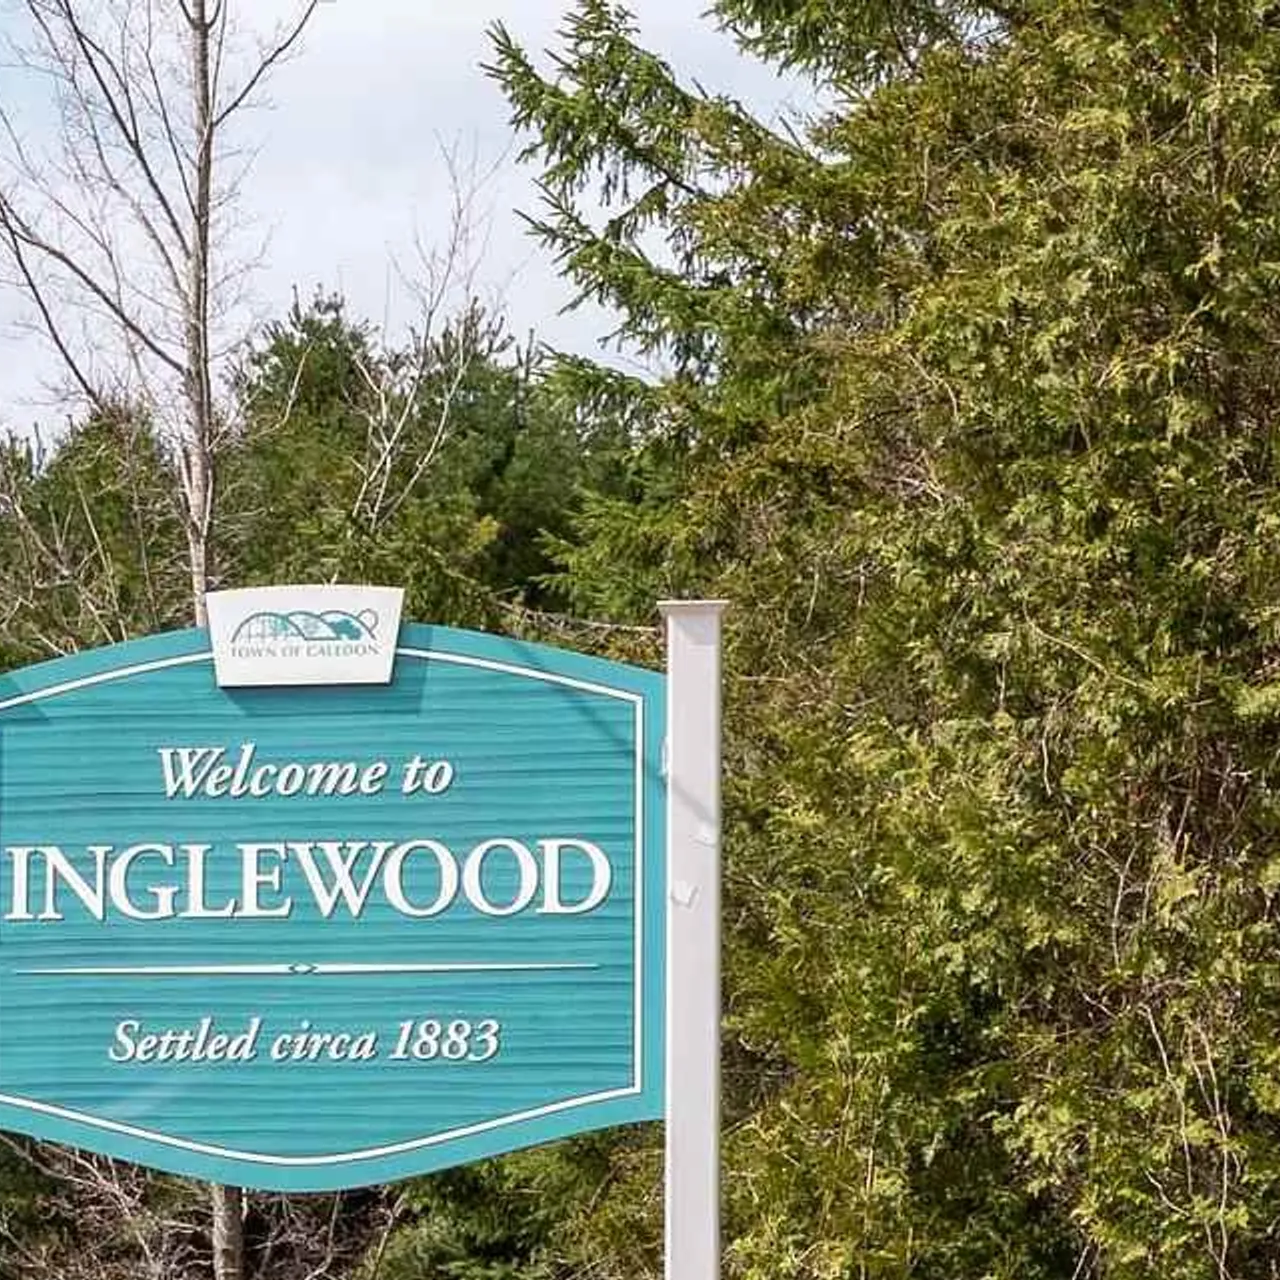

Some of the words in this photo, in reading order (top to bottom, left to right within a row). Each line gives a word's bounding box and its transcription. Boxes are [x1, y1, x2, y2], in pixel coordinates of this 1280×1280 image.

[231, 644, 278, 658] TOWN
[281, 644, 302, 658] OF
[306, 642, 380, 658] CALEDON
[158, 741, 388, 797] Welcome
[402, 754, 455, 796] to
[5, 838, 613, 922] INGLEWOOD
[109, 1018, 259, 1064] Settled
[272, 1022, 376, 1063] circa
[394, 1019, 501, 1063] 1883
